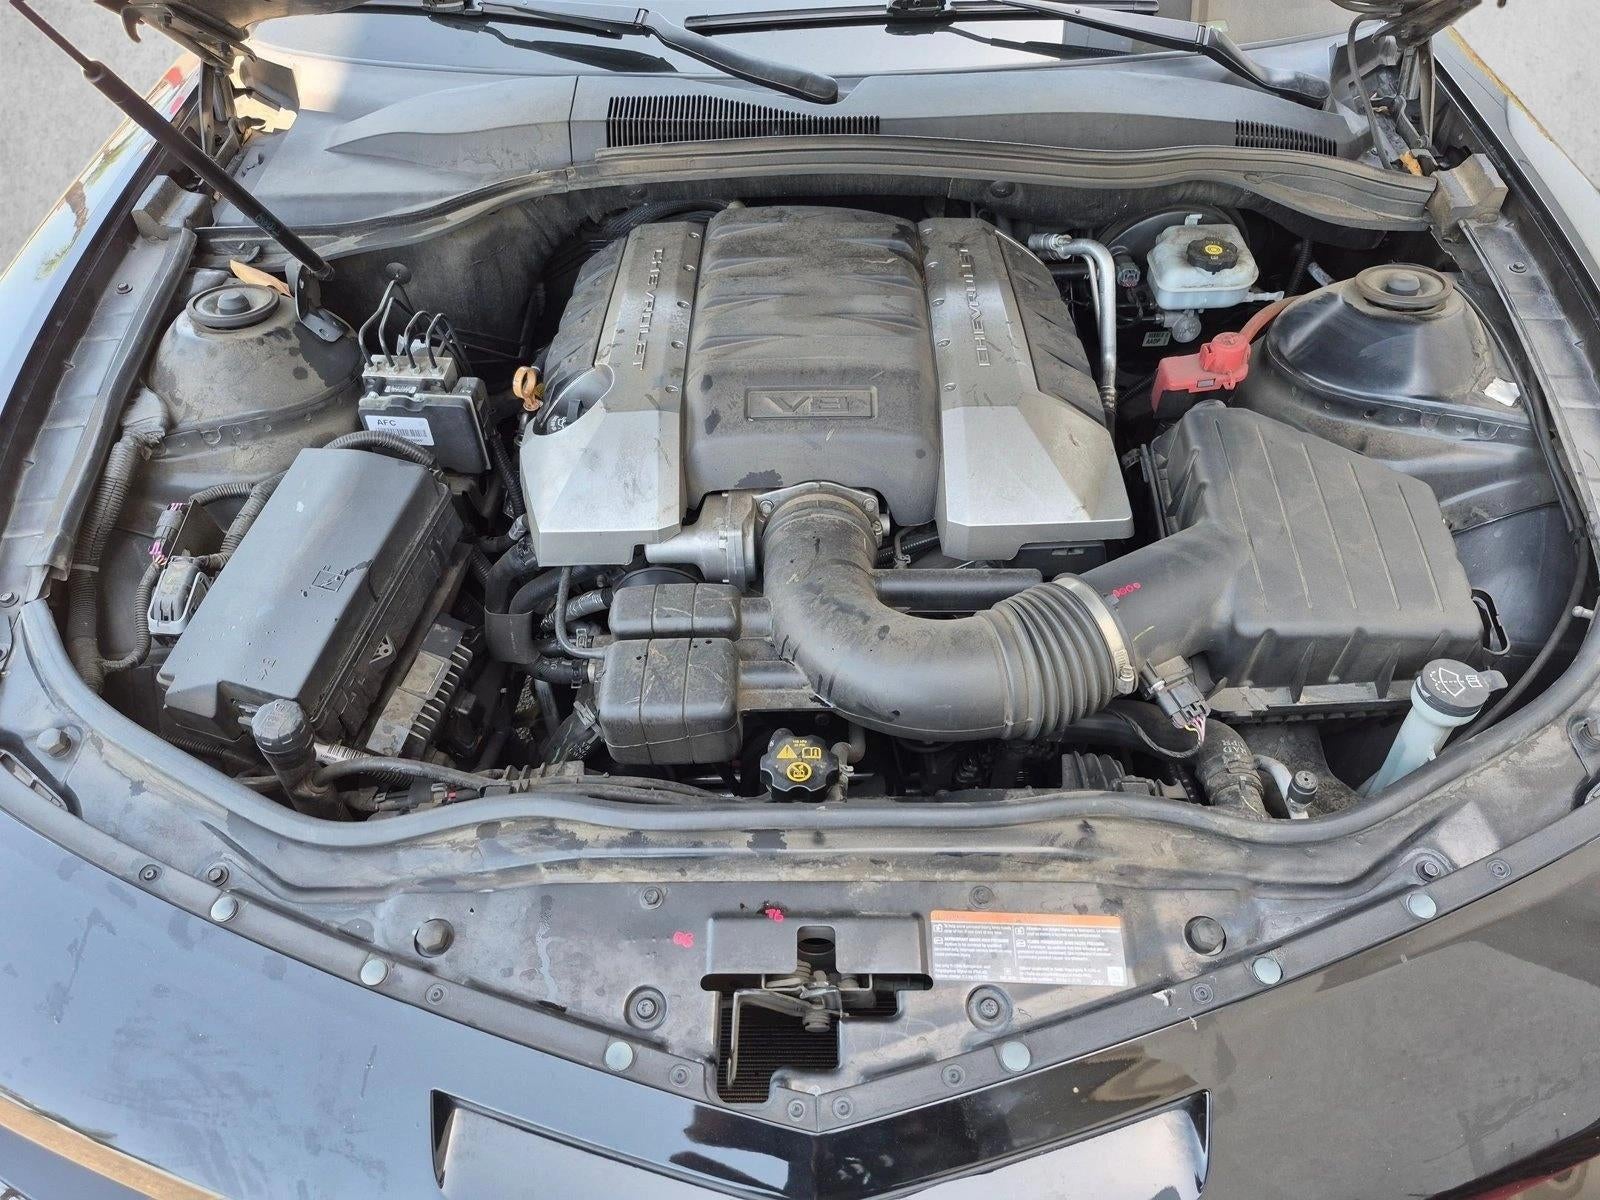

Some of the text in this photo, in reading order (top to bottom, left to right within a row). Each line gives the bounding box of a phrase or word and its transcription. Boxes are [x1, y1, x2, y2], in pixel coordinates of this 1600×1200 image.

[633, 248, 664, 370] CHEVROLET
[959, 248, 990, 366] CHEVROLET
[377, 419, 397, 427] AFC
